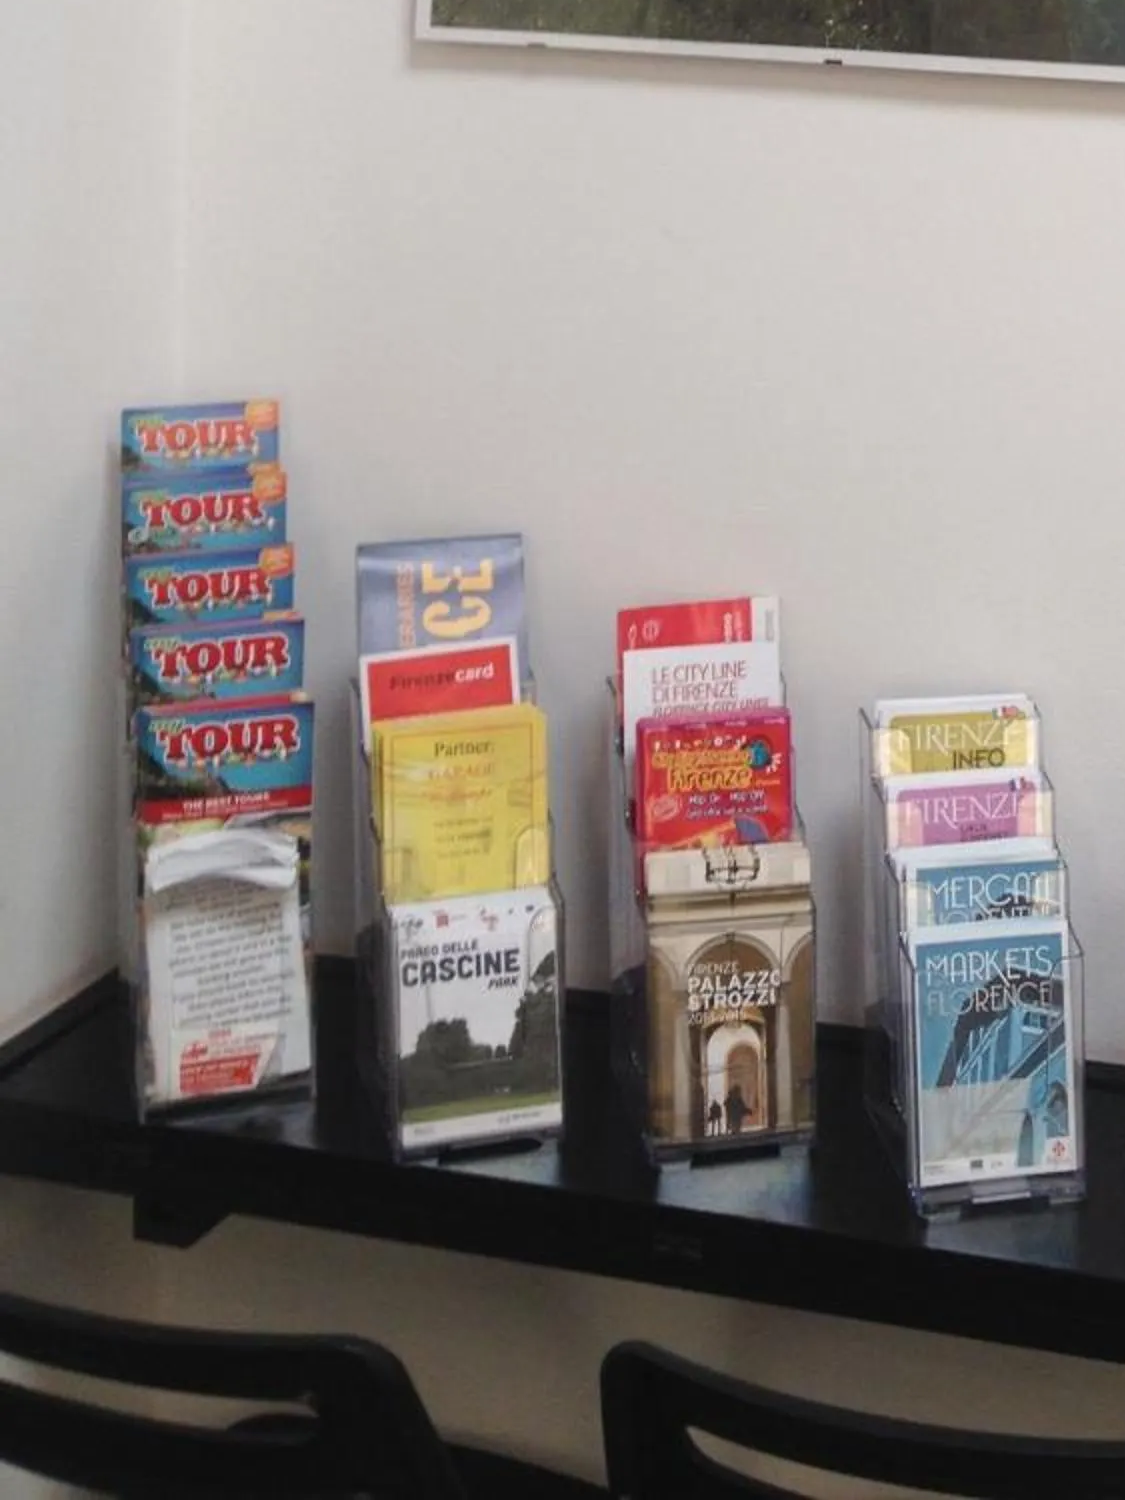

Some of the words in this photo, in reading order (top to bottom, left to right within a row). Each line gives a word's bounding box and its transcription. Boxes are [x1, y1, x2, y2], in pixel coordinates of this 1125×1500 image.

[136, 418, 258, 454] TOUR
[141, 493, 265, 527] TOUR
[147, 567, 271, 605] TOUR
[152, 634, 290, 678] TOUR
[673, 662, 711, 682] CITY
[713, 660, 747, 680] LINE
[670, 681, 736, 702] FIRENZE
[158, 717, 299, 760] TOUR
[951, 748, 1006, 770] INFO
[668, 766, 750, 791] Firenze
[402, 949, 521, 987] CASCINE
[688, 969, 781, 993] PALAZZO
[926, 946, 1052, 986] MARKETS
[688, 989, 776, 1011] STROZZI
[927, 981, 1051, 1017] FLORENCE
